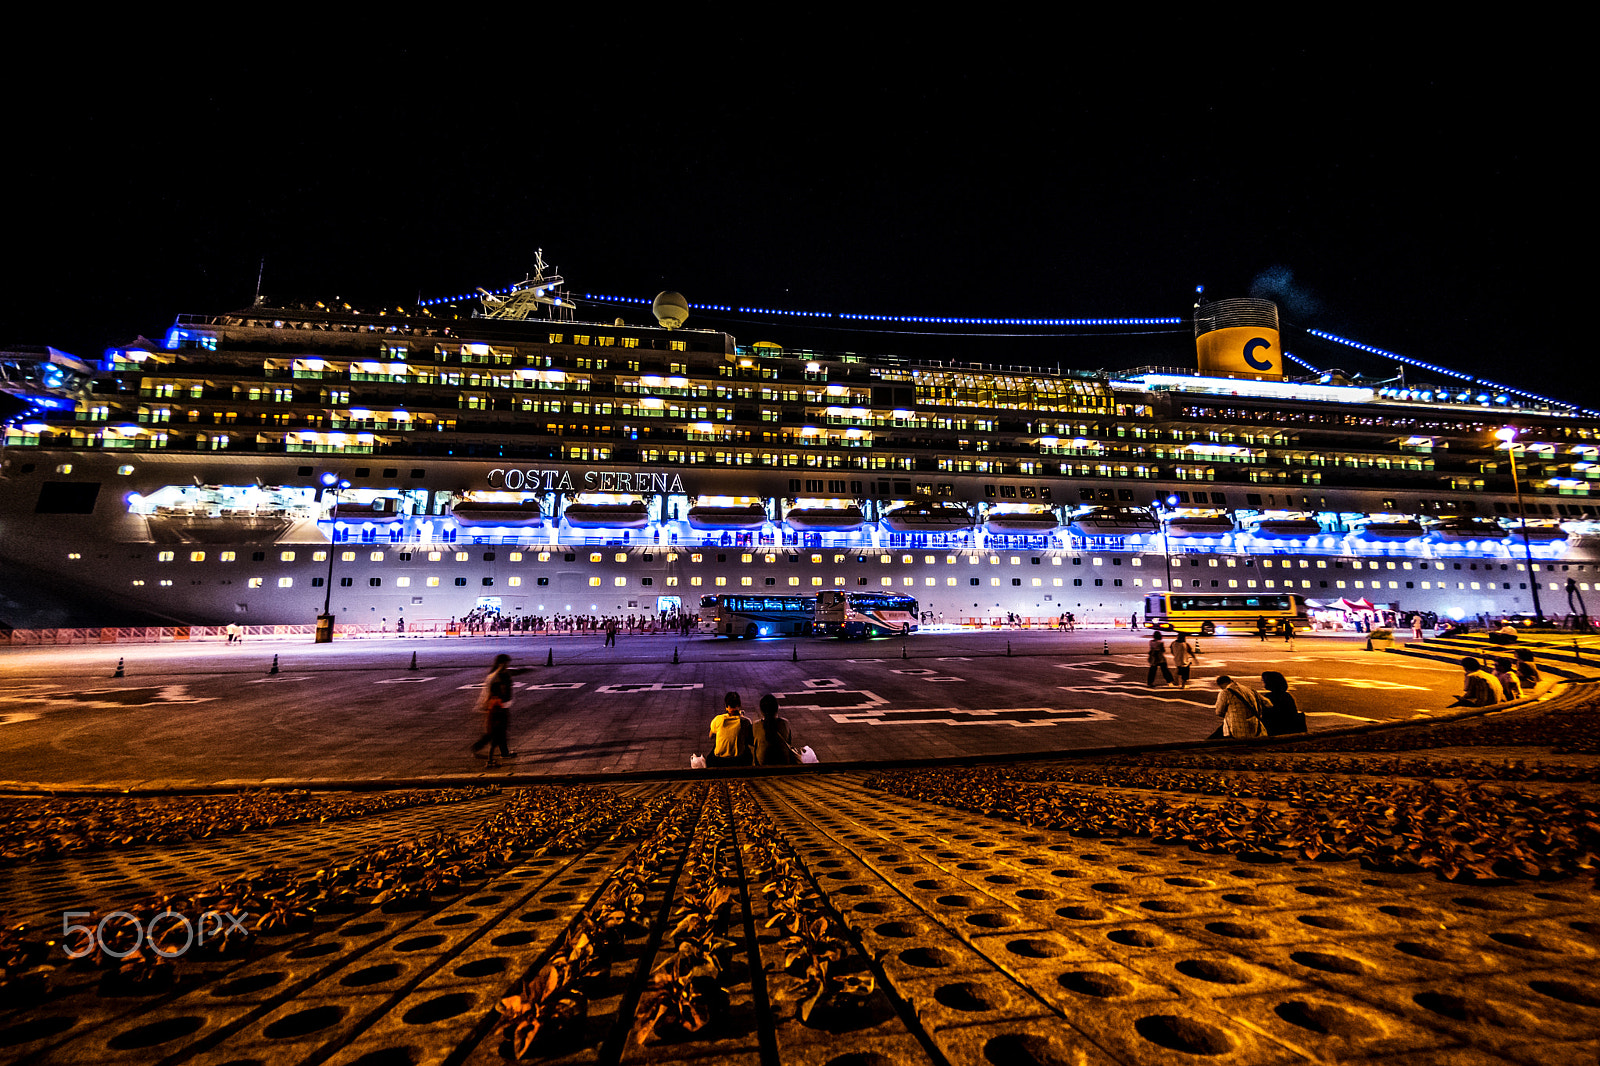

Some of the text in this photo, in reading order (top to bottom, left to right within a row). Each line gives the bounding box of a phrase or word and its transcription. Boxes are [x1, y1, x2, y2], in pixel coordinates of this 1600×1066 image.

[1243, 337, 1273, 371] C
[487, 468, 686, 493] COSTA SERENA
